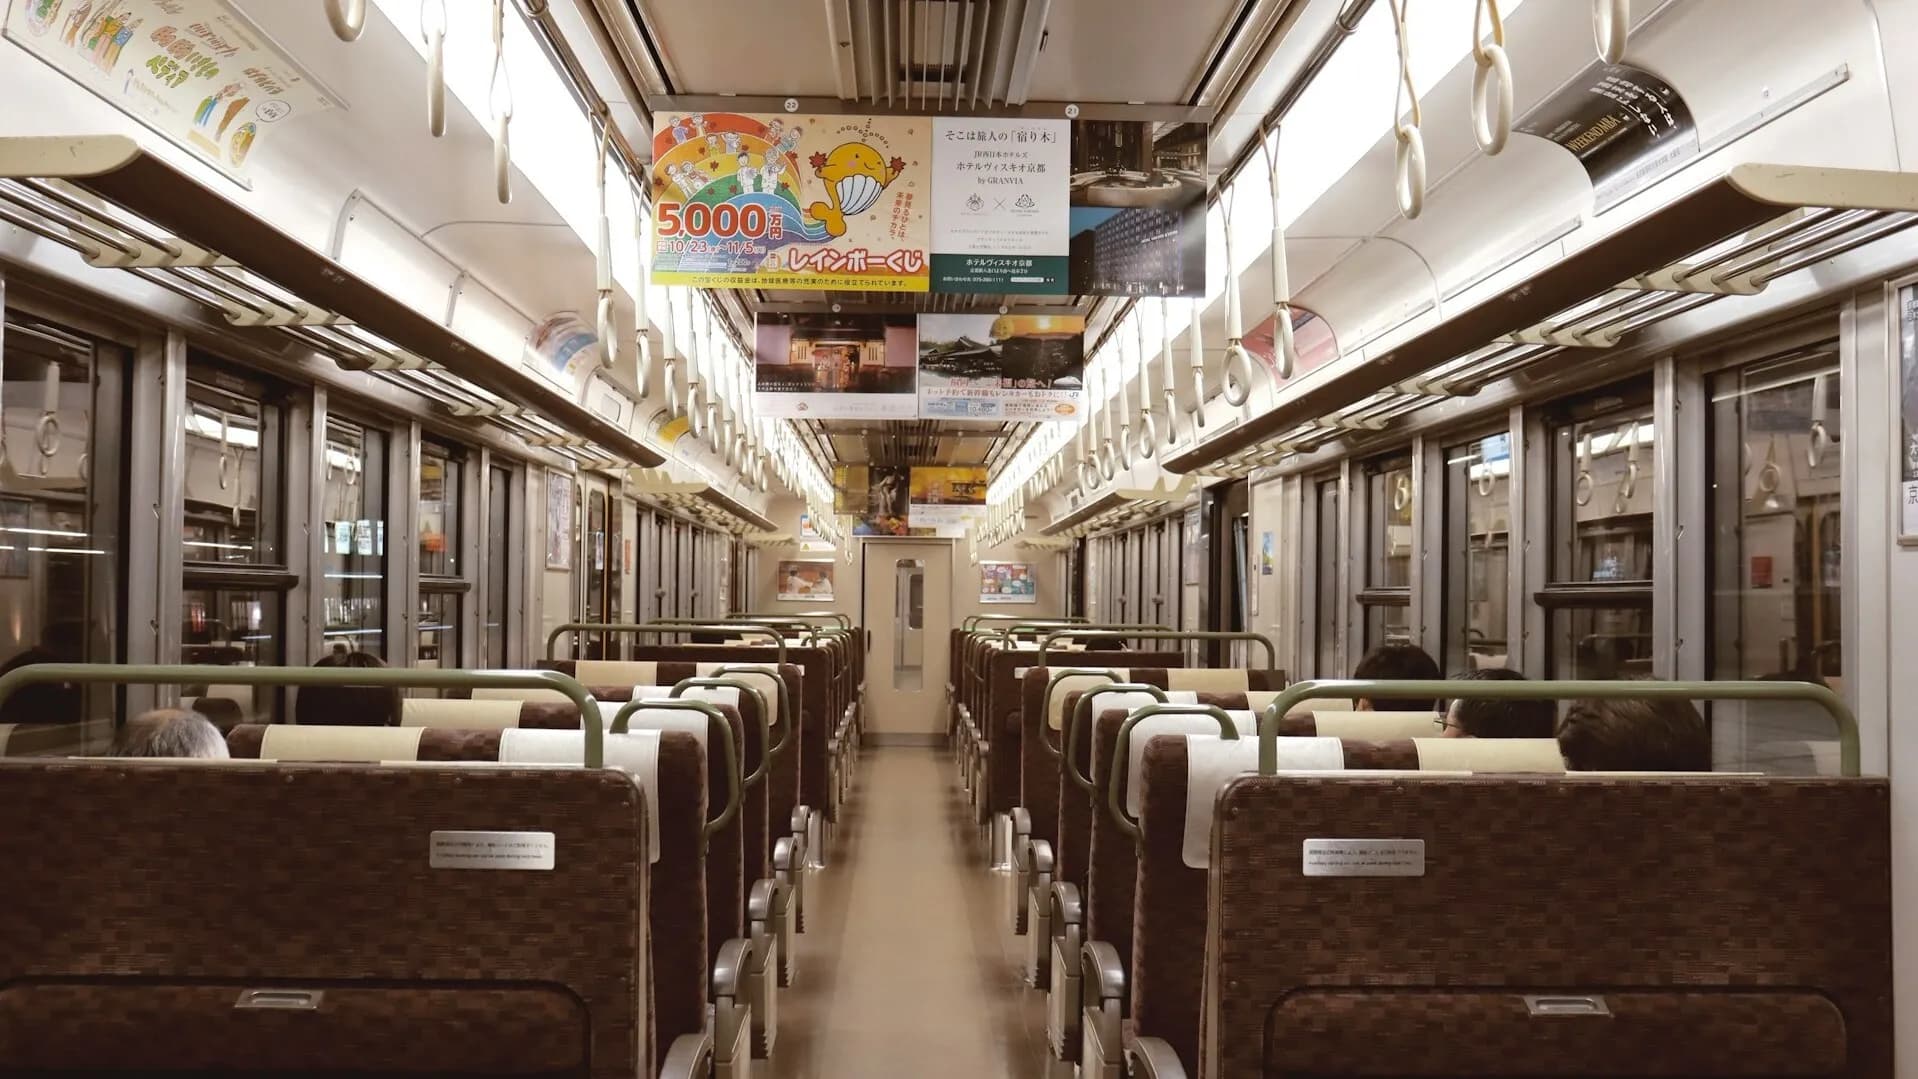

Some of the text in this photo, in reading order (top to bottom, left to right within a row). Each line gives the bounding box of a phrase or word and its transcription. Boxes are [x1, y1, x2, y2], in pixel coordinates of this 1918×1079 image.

[946, 130, 1056, 145] そこは旅人の「宿り木」
[956, 162, 1046, 174] ホテルヴィスキオ京都
[977, 177, 1024, 186] by GRANVIA
[658, 202, 768, 239] 5,000
[768, 213, 783, 240] 万円
[788, 247, 923, 273] レインボーくじ
